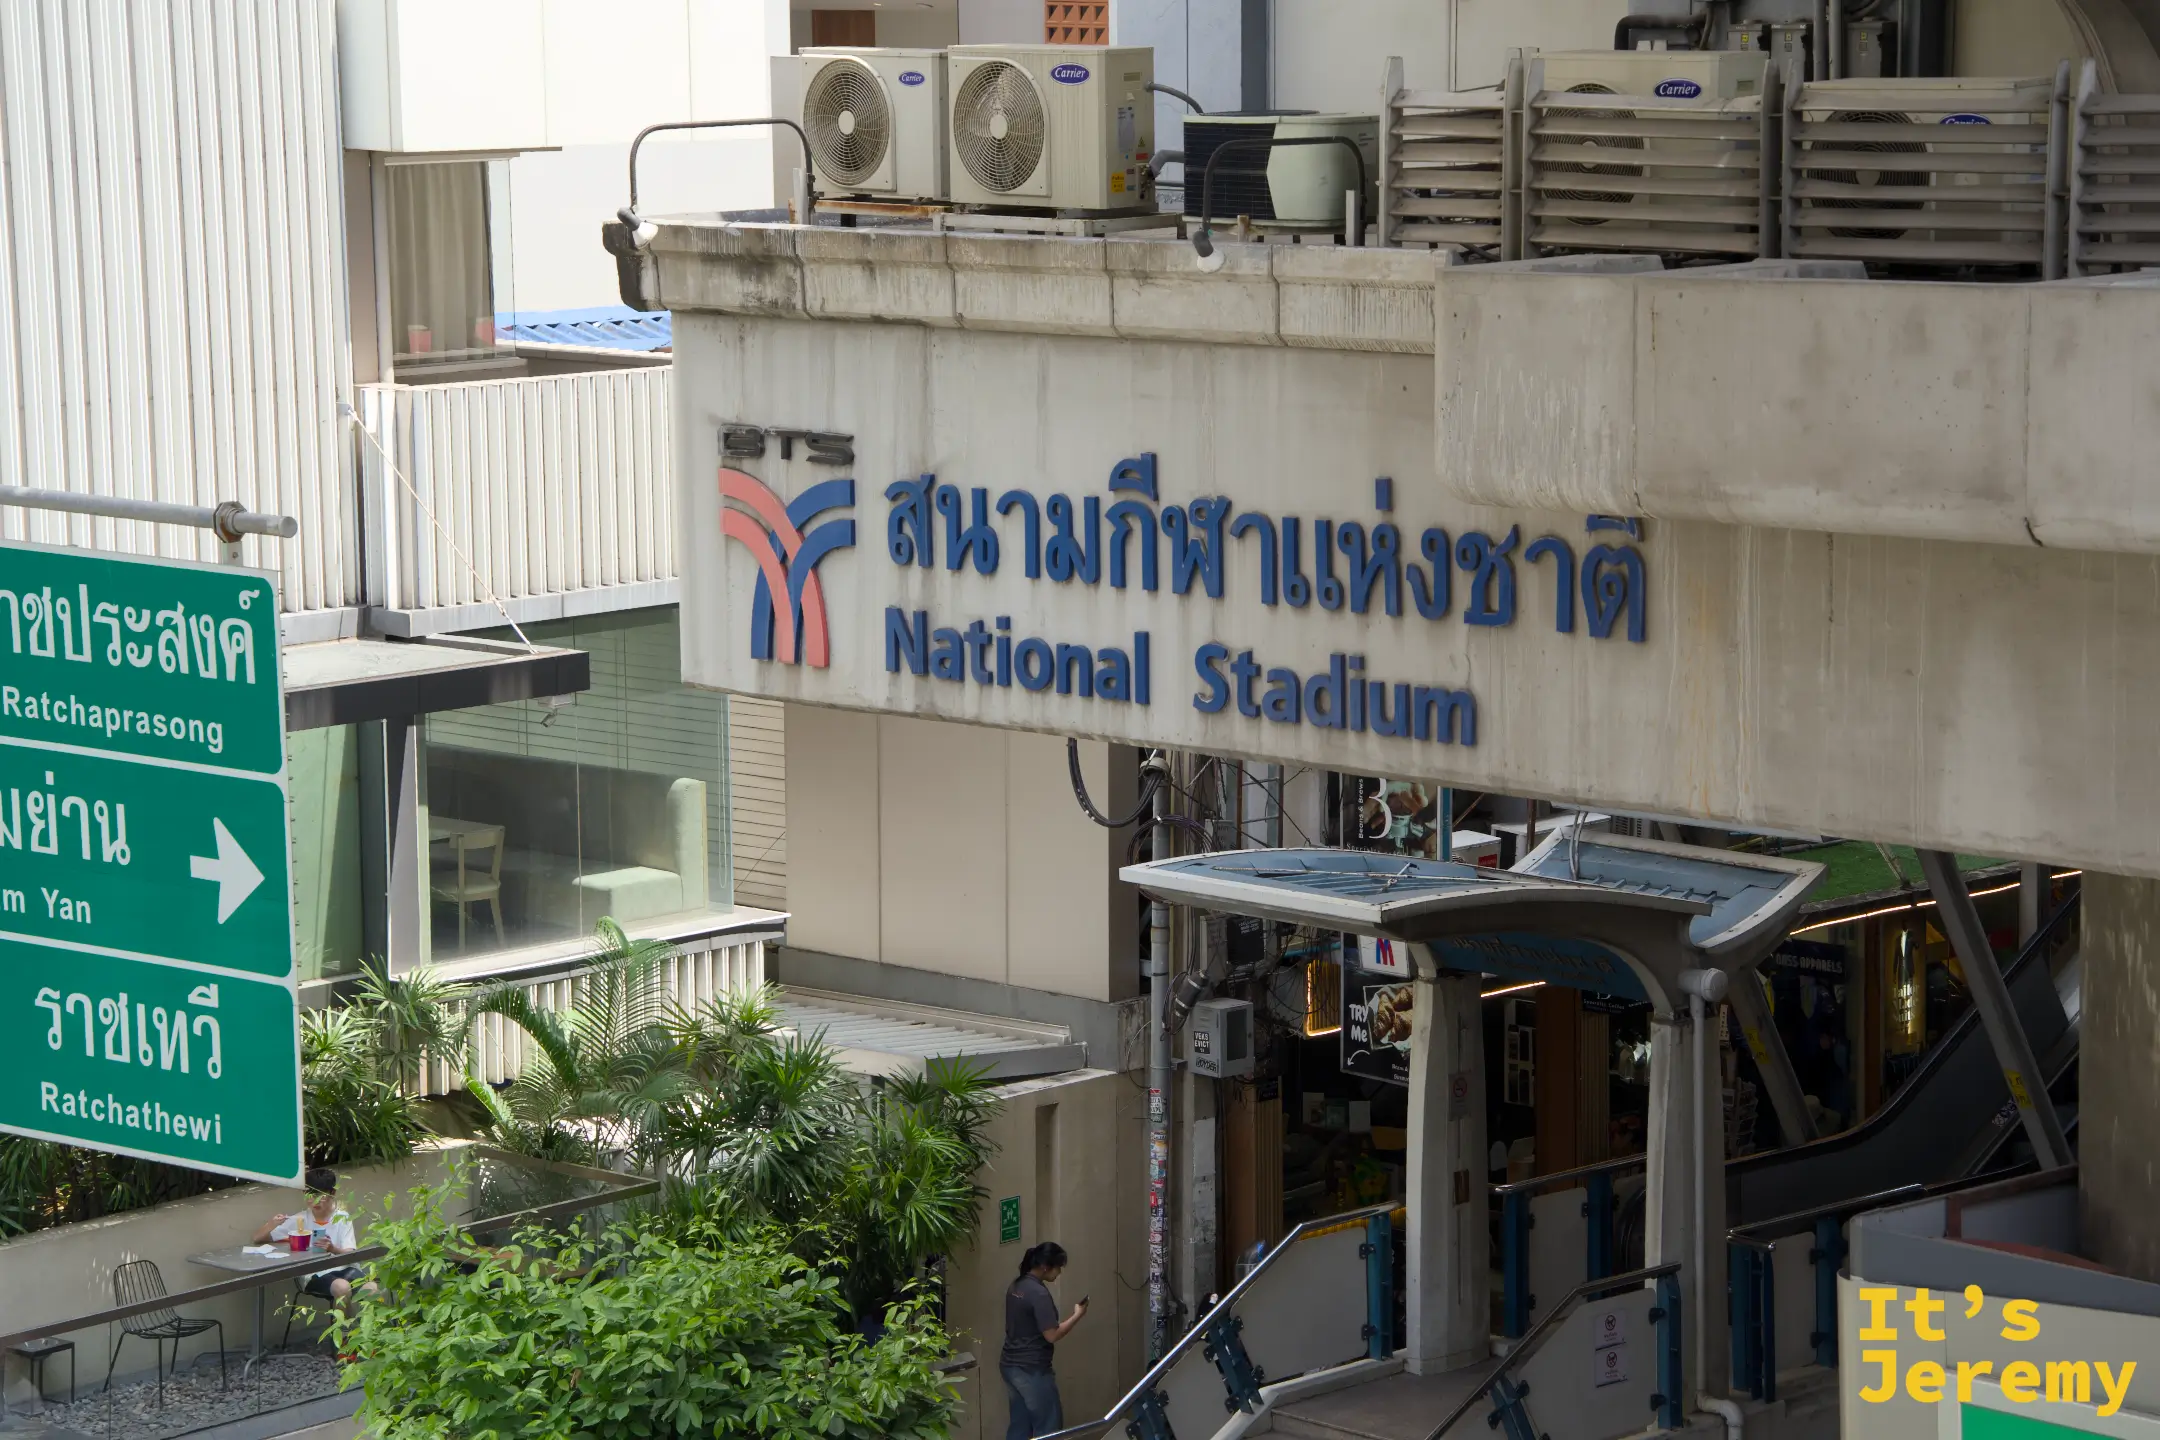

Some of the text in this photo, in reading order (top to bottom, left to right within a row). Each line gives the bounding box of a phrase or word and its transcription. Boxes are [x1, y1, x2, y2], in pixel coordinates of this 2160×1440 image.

[901, 73, 922, 83] Carrier
[1054, 65, 1087, 80] Carrier
[1659, 82, 1697, 96] Carrier
[717, 424, 855, 466] BTS
[884, 606, 1478, 748] National Stadium
[2, 686, 224, 754] Ratchaprasong
[0, 887, 92, 925] m Yan
[1348, 1003, 1369, 1021] TRY
[34, 983, 223, 1080] ราชเทวี
[1194, 1040, 1210, 1048] EVICT
[1350, 1024, 1368, 1043] Me
[40, 1081, 222, 1145] Ratchathewi
